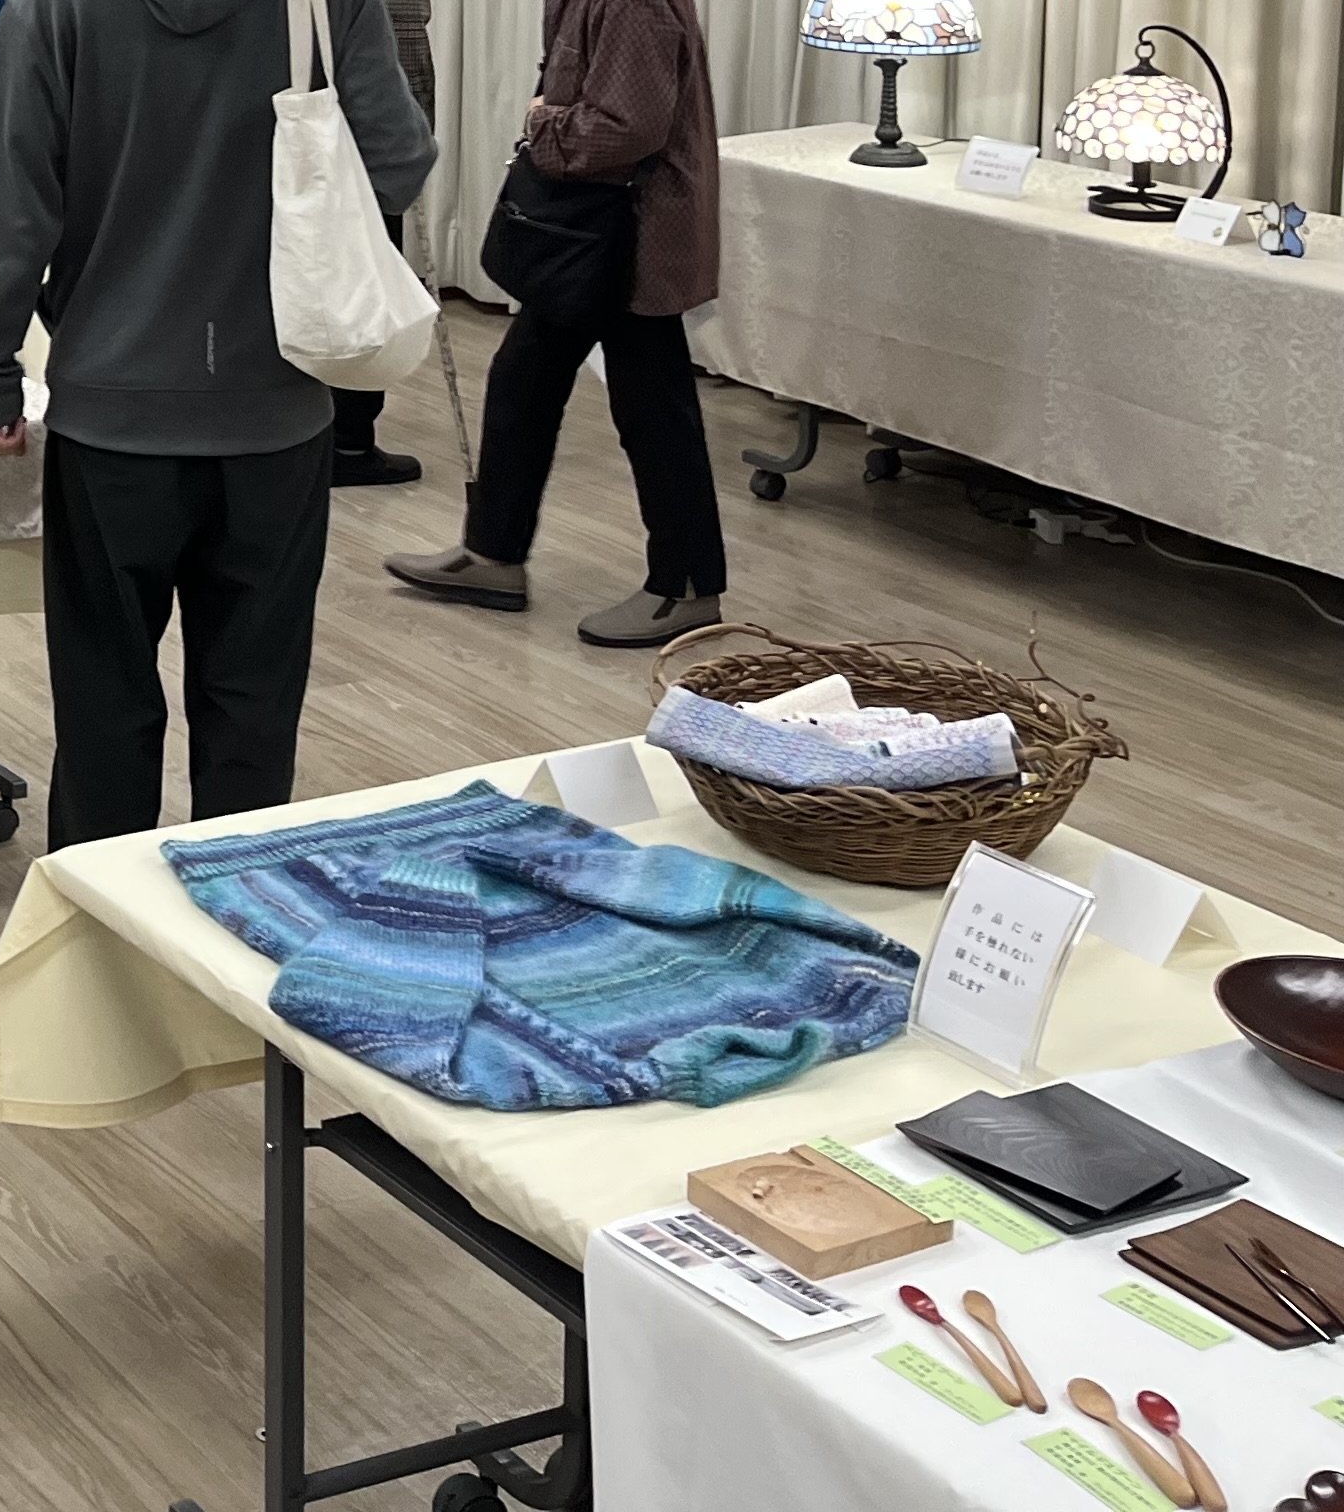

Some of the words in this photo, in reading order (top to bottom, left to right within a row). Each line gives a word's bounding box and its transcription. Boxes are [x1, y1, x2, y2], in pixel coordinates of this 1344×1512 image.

[972, 903, 1043, 943] 作品には
[964, 925, 1034, 964] 手を触れない
[947, 969, 985, 994] 致します
[955, 946, 1025, 986] 様にお願い
